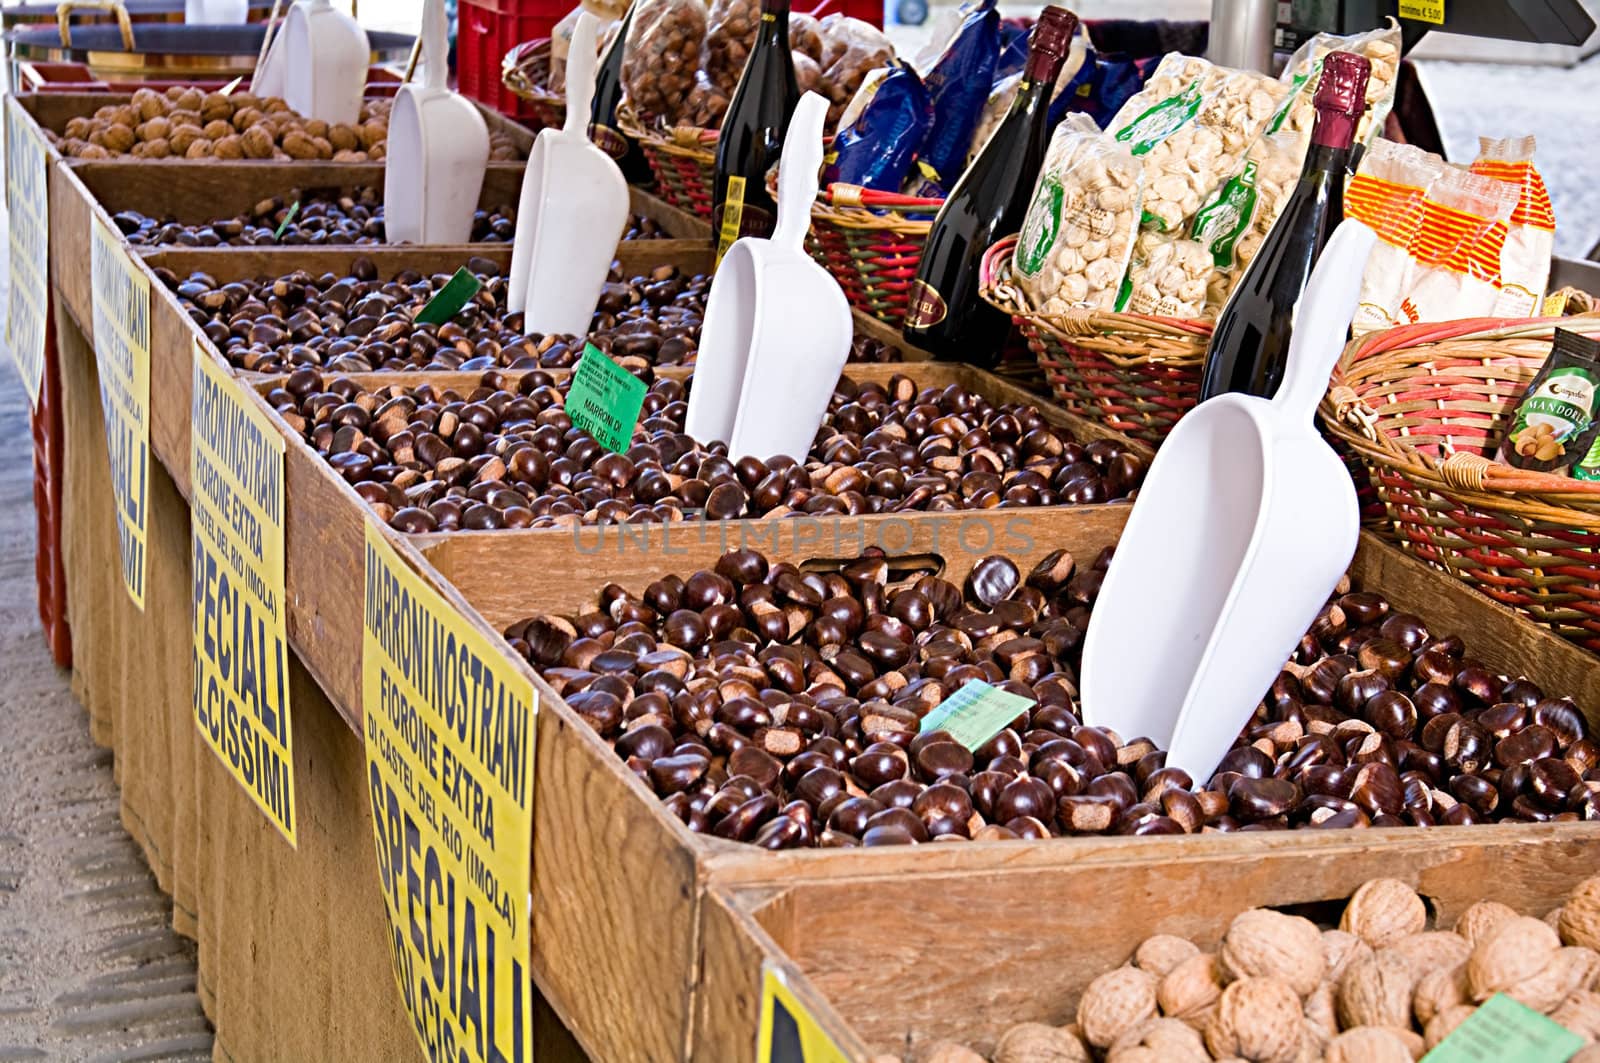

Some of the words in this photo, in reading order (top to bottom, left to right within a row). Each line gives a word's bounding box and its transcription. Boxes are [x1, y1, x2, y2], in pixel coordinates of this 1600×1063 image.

[228, 400, 281, 528] NOSTRANI
[571, 409, 594, 433] CASTEL
[596, 426, 608, 444] DEL
[584, 398, 614, 426] MARRONI
[614, 420, 622, 433] DI
[1527, 400, 1586, 425] MANDORLE
[194, 495, 216, 542] CASTEL
[217, 525, 229, 561] DEL
[231, 544, 243, 579] RIO
[245, 561, 277, 624] (IMOLA)
[196, 448, 231, 523] FIORONE
[232, 493, 263, 563] EXTRA
[365, 542, 430, 703] MARRONI
[431, 617, 529, 811] NOSTRANI
[381, 667, 438, 781] FIORONE
[442, 743, 495, 852] EXTRA
[368, 711, 378, 747] DI
[379, 729, 415, 802] CASTEL
[418, 783, 439, 833] DEL
[442, 813, 462, 862] RIO
[466, 844, 516, 940] (IMOLA)
[370, 759, 523, 1063] SPECIALI
